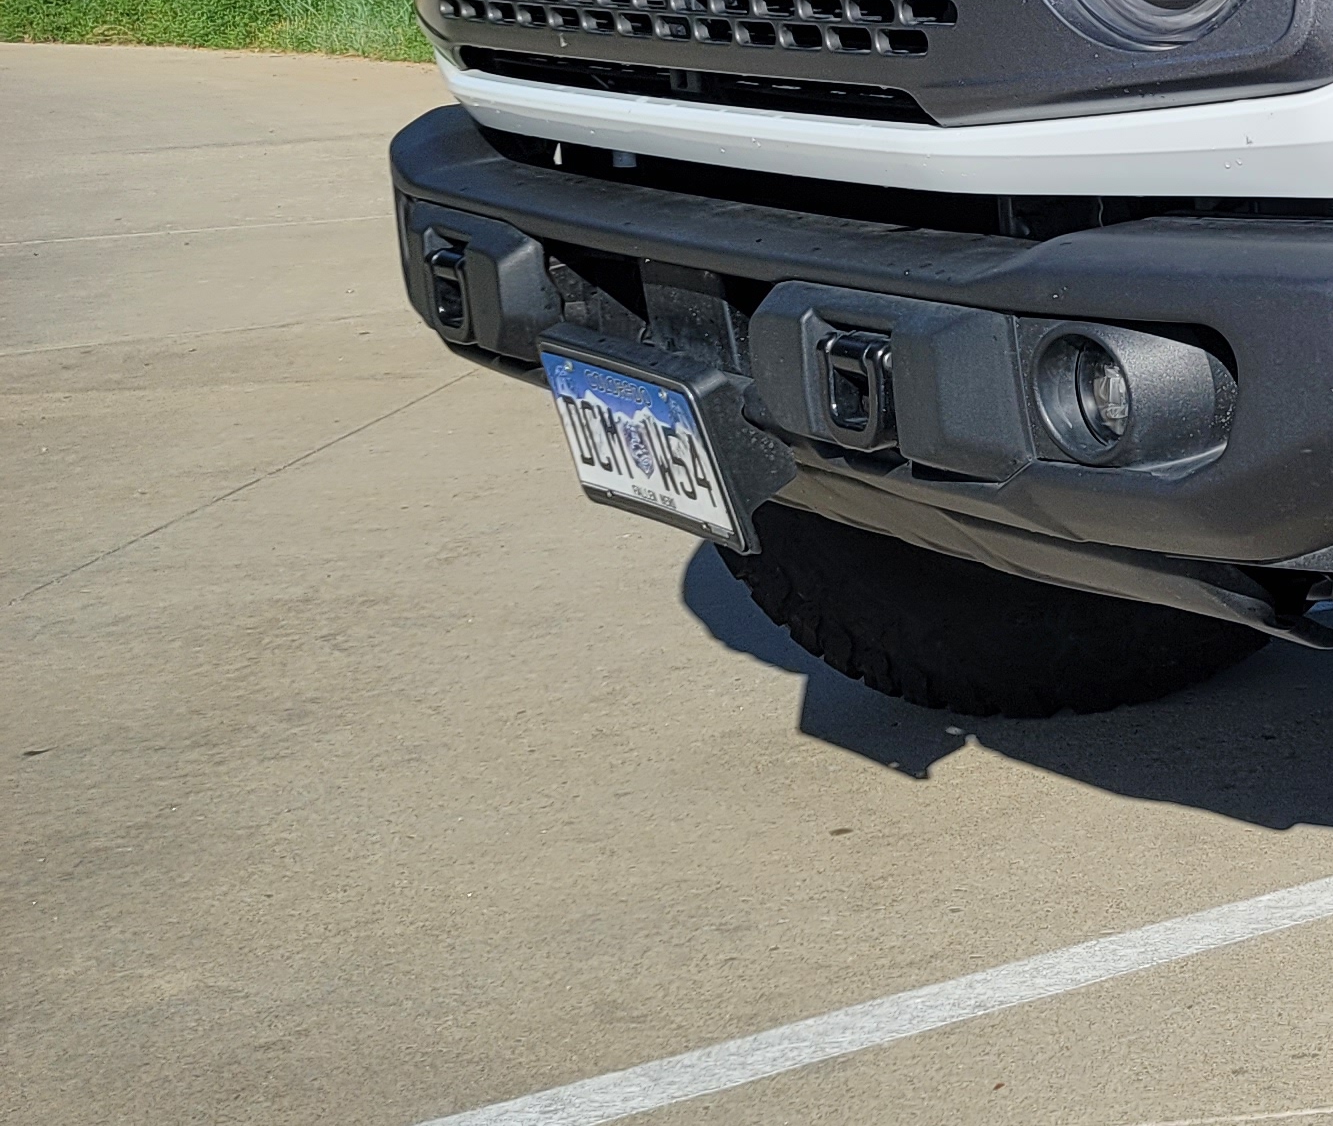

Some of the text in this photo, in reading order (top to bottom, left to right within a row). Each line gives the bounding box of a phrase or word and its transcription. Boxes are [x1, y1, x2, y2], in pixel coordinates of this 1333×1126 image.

[584, 368, 654, 408] COLORADO
[559, 393, 718, 508] DCM W54
